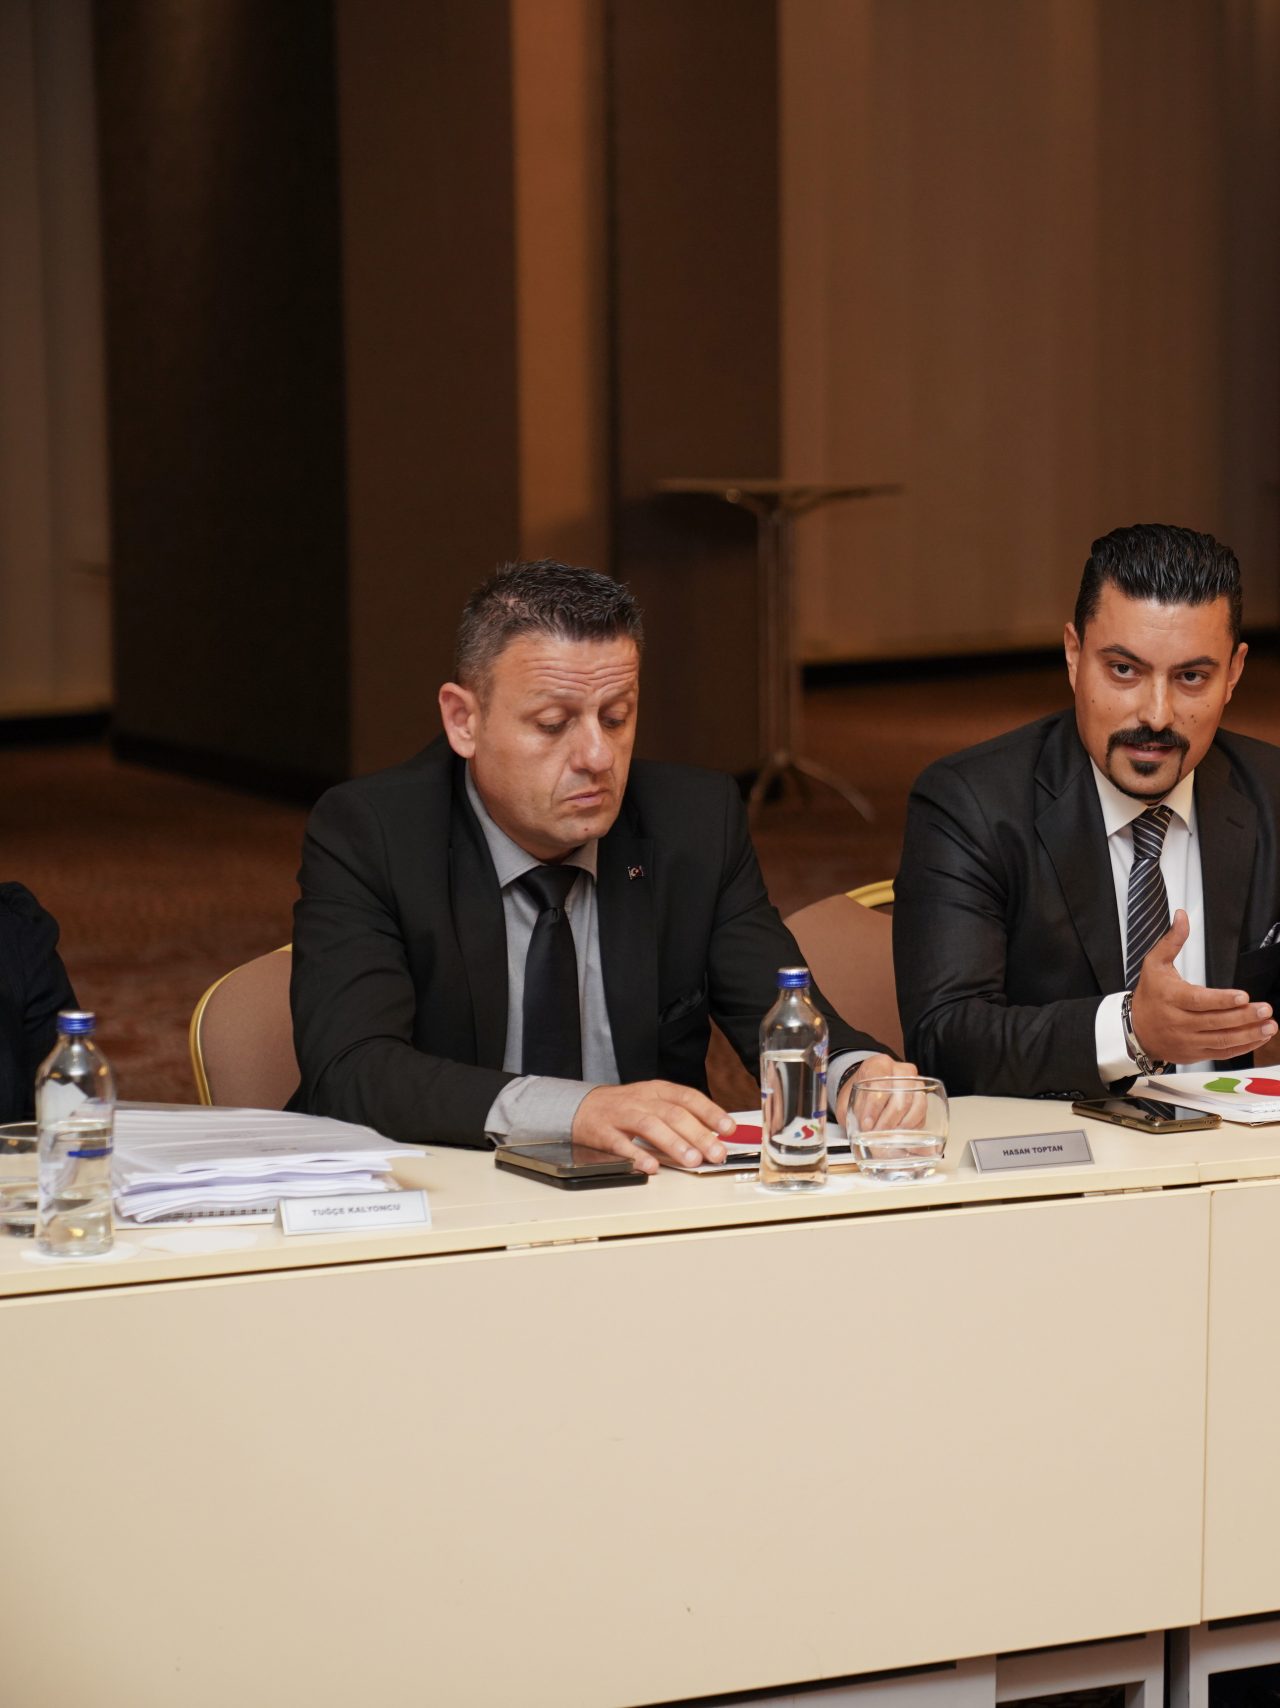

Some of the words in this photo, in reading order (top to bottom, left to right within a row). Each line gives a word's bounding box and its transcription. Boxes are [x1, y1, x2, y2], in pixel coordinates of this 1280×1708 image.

[1002, 1147, 1031, 1157] HASAN
[1031, 1144, 1064, 1154] TOPTAN
[311, 1206, 345, 1217] TUĞÇE
[347, 1203, 401, 1215] KALYONCU
